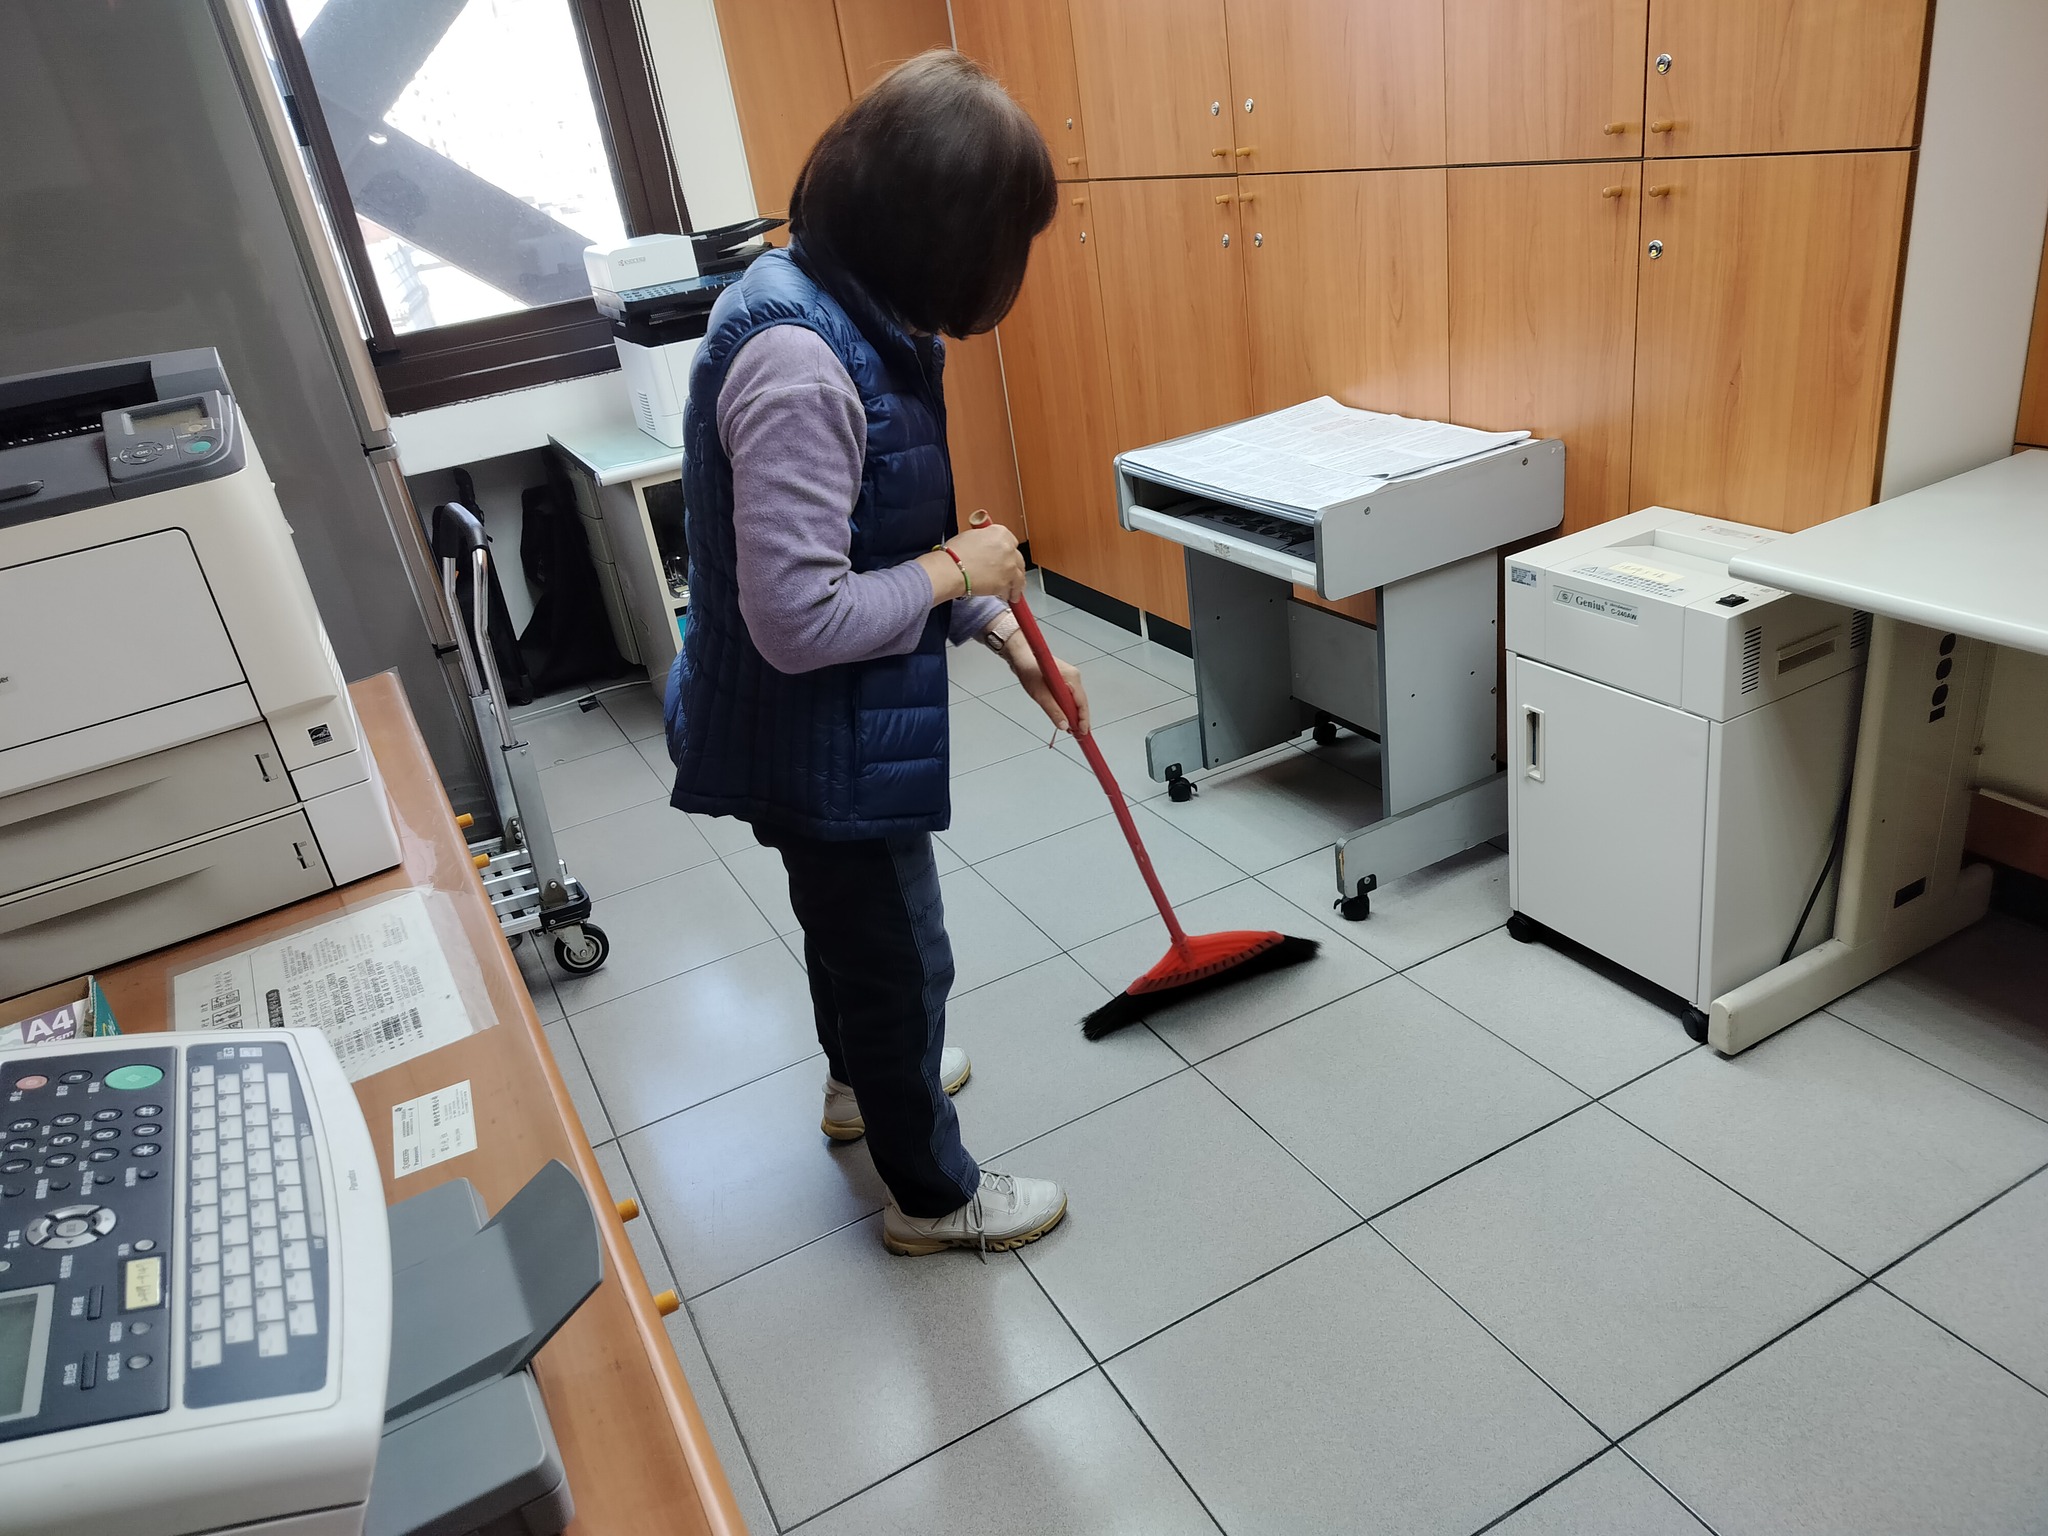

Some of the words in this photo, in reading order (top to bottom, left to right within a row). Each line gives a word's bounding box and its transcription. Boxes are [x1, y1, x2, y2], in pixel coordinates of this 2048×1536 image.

[1575, 595, 1605, 612] Genius
[26, 1009, 74, 1043] A4
[98, 1111, 116, 1119] 9
[56, 1116, 74, 1124] 6
[13, 1121, 32, 1129] 3
[138, 1126, 156, 1134] 0
[96, 1131, 114, 1139] 8
[53, 1135, 72, 1144] 5
[10, 1142, 28, 1150] 2
[95, 1152, 113, 1160] 7
[51, 1157, 68, 1165] 4
